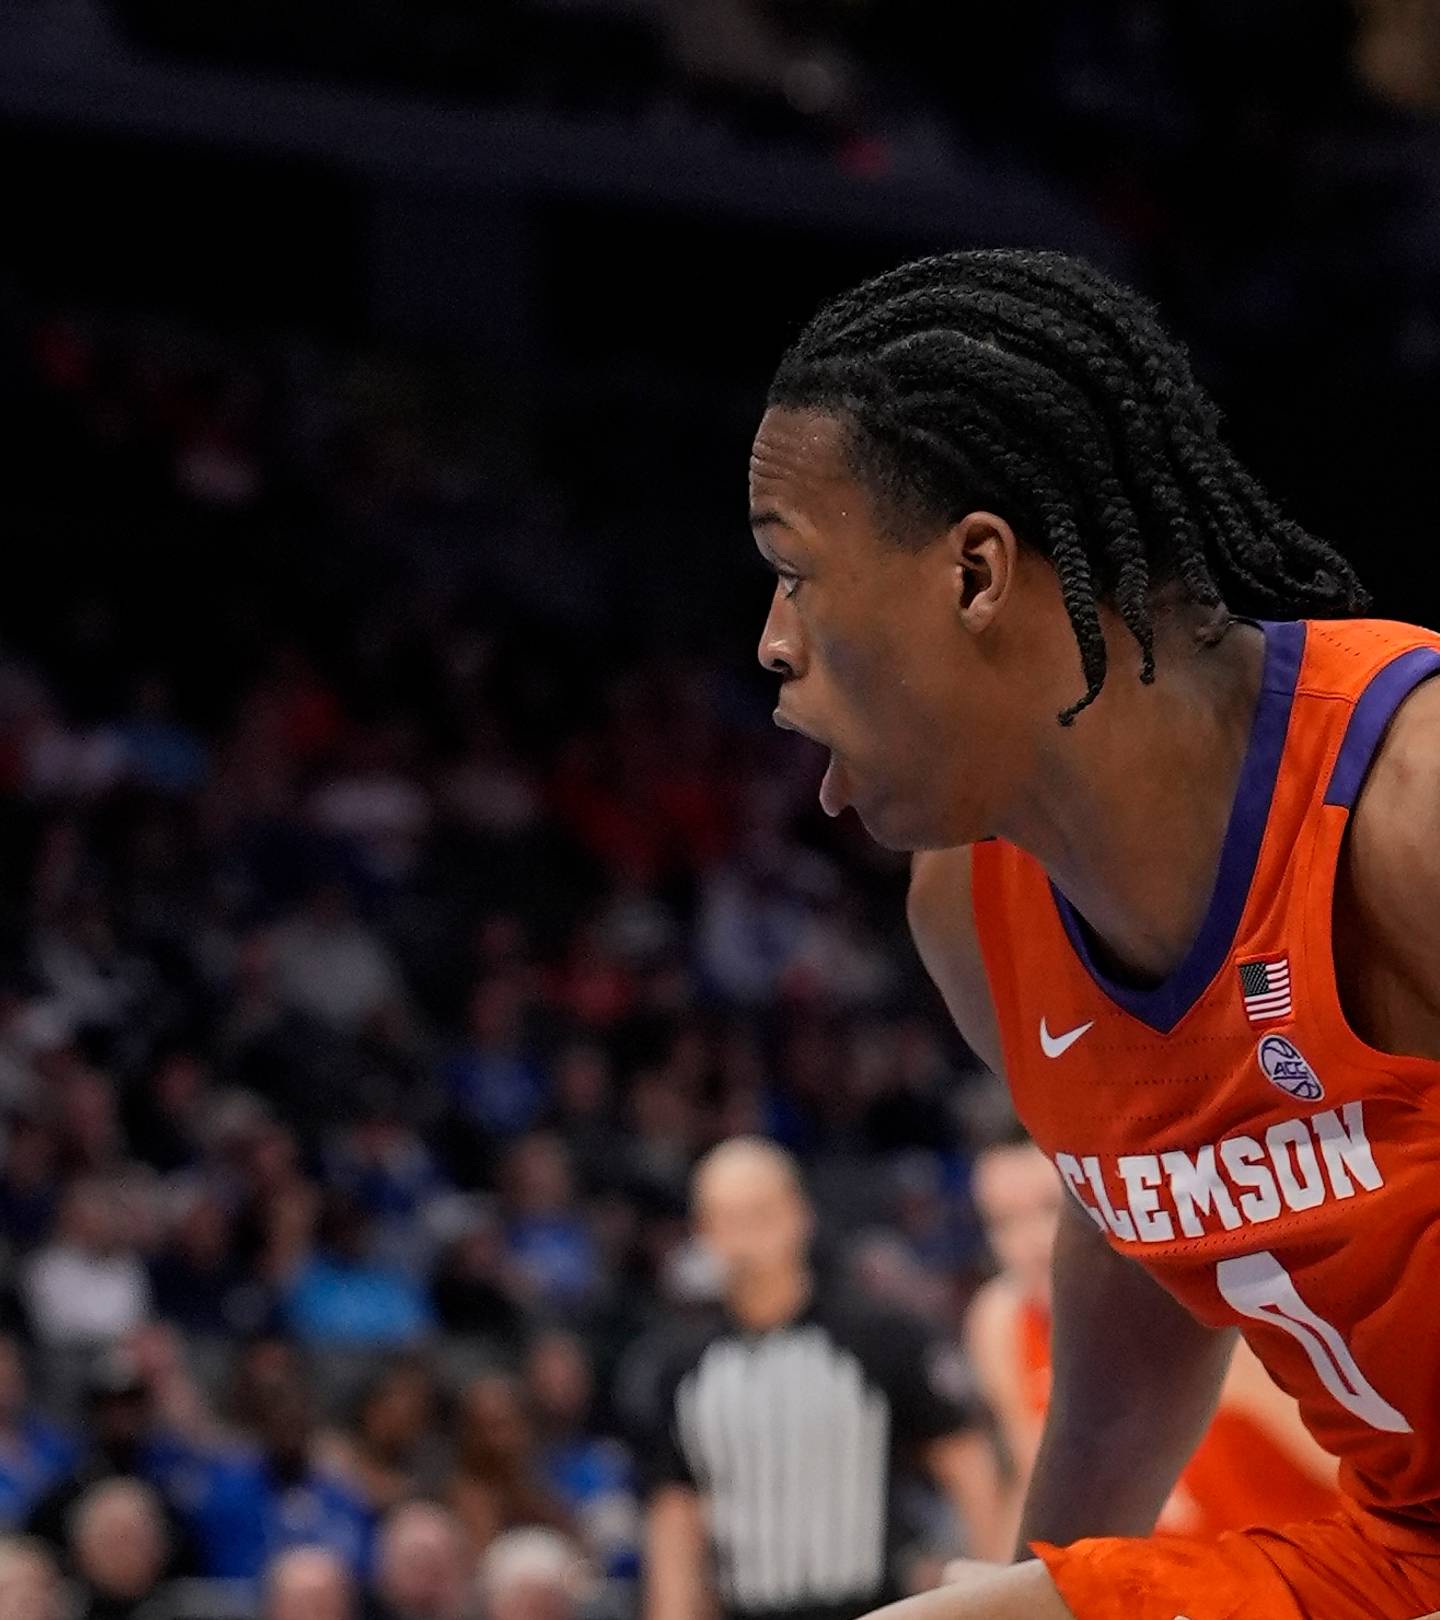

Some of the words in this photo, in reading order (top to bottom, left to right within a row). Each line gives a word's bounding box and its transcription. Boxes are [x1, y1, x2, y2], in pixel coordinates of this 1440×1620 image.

[1273, 1061, 1308, 1076] ACC
[1055, 1101, 1384, 1242] CLEMSON
[1216, 1251, 1414, 1433] 0
